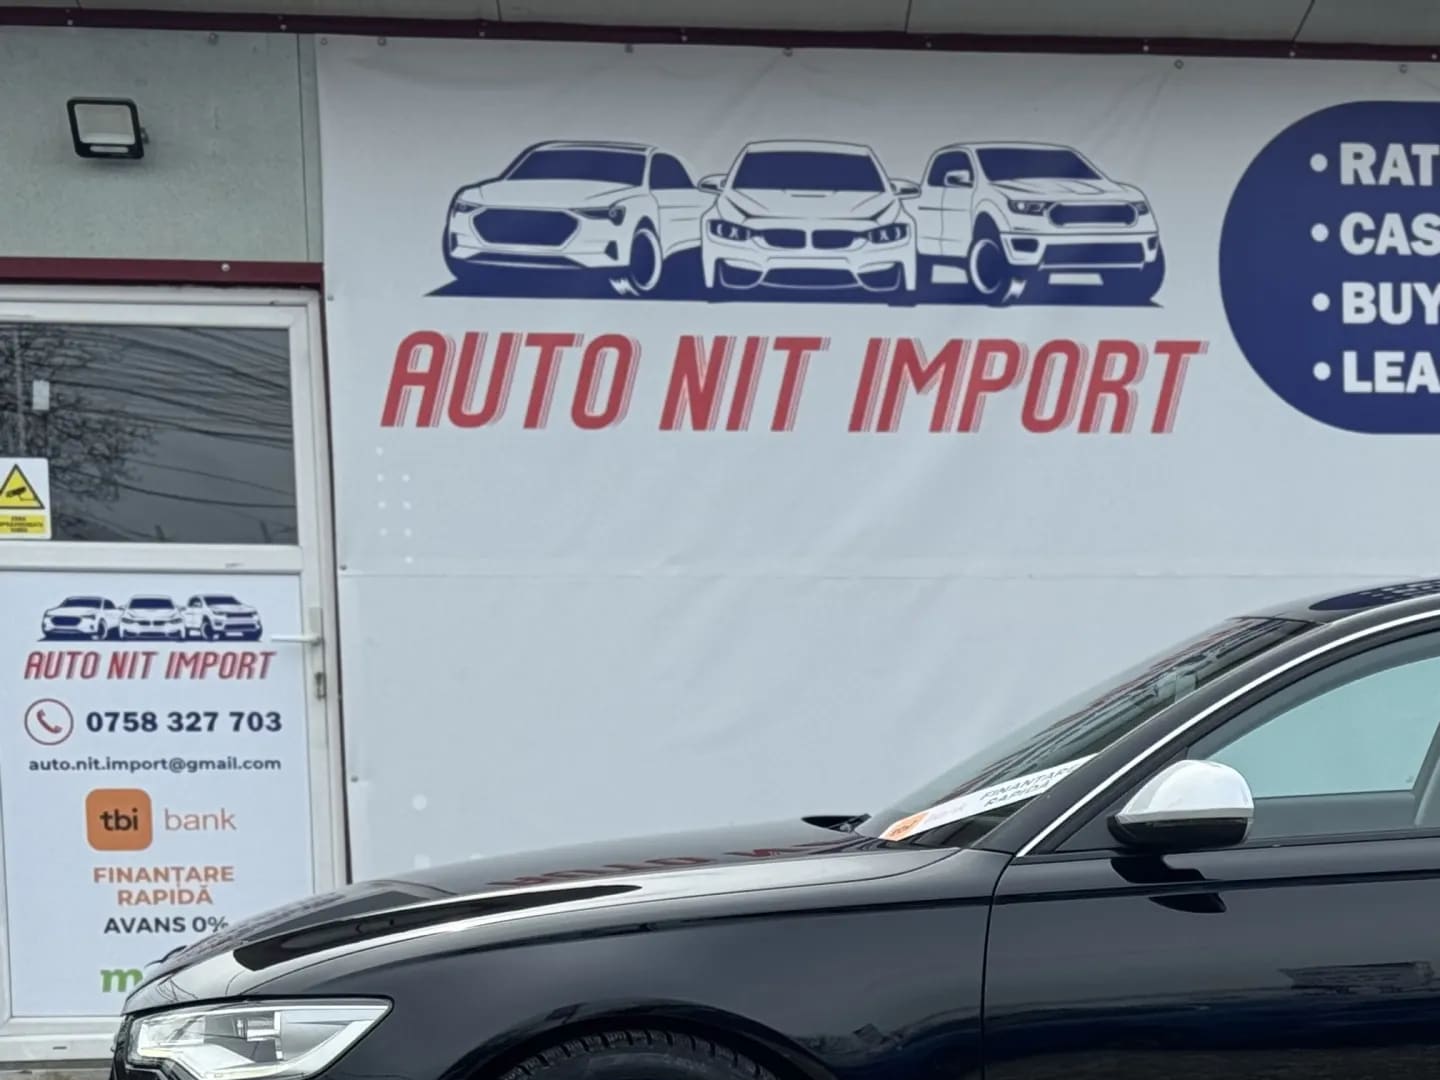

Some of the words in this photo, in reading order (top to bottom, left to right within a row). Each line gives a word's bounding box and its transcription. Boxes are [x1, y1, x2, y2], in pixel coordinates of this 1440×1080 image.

[380, 330, 642, 429] AUTO
[658, 335, 830, 433] NIT
[847, 338, 1209, 435] IMPORT
[24, 651, 101, 680] AUTO
[107, 651, 158, 680] NIT
[164, 651, 277, 680] IMPORT
[86, 711, 158, 732] 0758
[167, 711, 219, 732] 327
[229, 711, 282, 732] 703
[28, 756, 282, 773] auto.nit.import@gmail.com
[99, 808, 139, 831] tbi
[164, 808, 237, 831] bank
[117, 885, 214, 906] RAPIDĂ
[104, 916, 187, 935] AVANS
[192, 916, 229, 934] 0%
